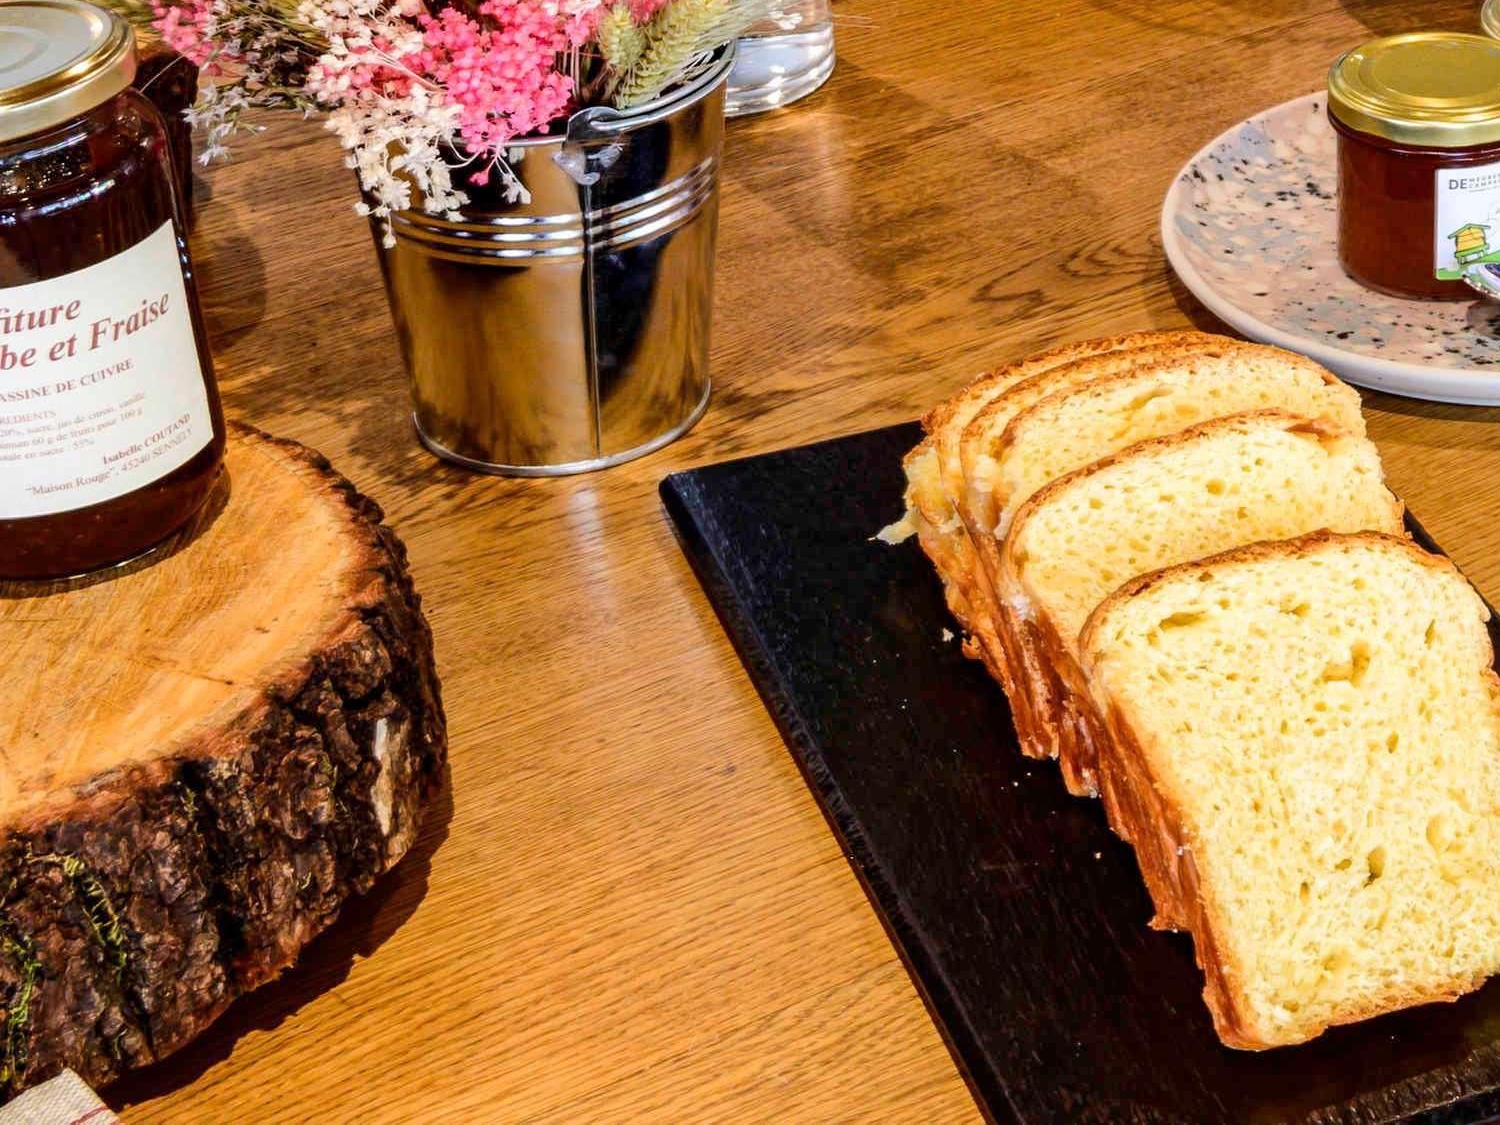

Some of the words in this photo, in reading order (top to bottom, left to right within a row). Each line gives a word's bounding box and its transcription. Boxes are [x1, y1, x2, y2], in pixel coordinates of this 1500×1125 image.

[49, 332, 77, 362] et
[88, 293, 170, 351] Fraise
[56, 379, 77, 394] DE
[80, 359, 134, 386] CUIVRE
[103, 445, 142, 465] Isabelle
